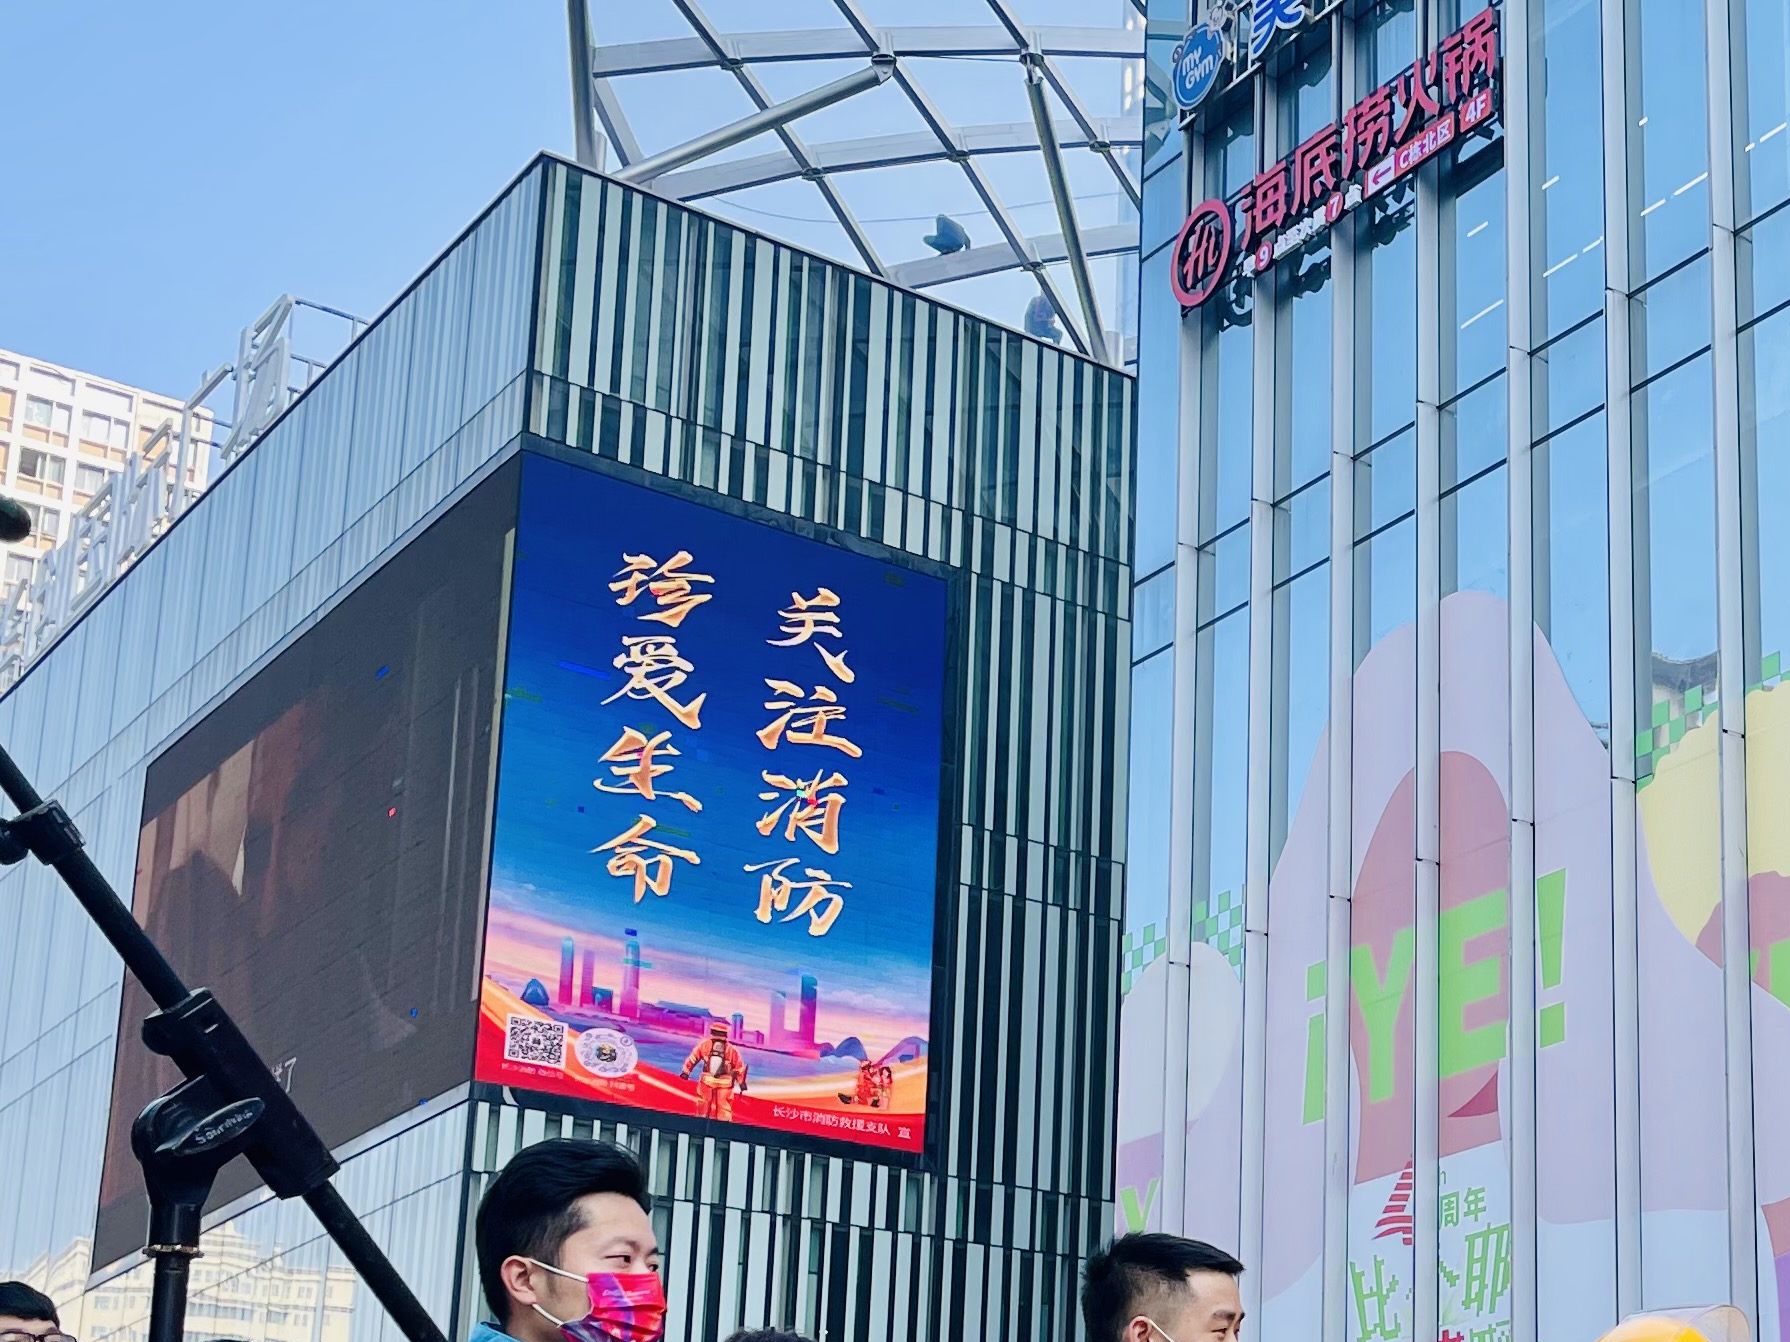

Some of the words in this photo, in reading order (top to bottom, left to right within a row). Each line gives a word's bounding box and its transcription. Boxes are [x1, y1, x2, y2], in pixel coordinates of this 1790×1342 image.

[1240, 6, 1497, 250] 海底捞火锅
[1465, 93, 1488, 123] 4F
[593, 551, 715, 904] 珍爱生命
[744, 587, 864, 938] 关注消防
[772, 1105, 891, 1137] 长沙市消防救援支队
